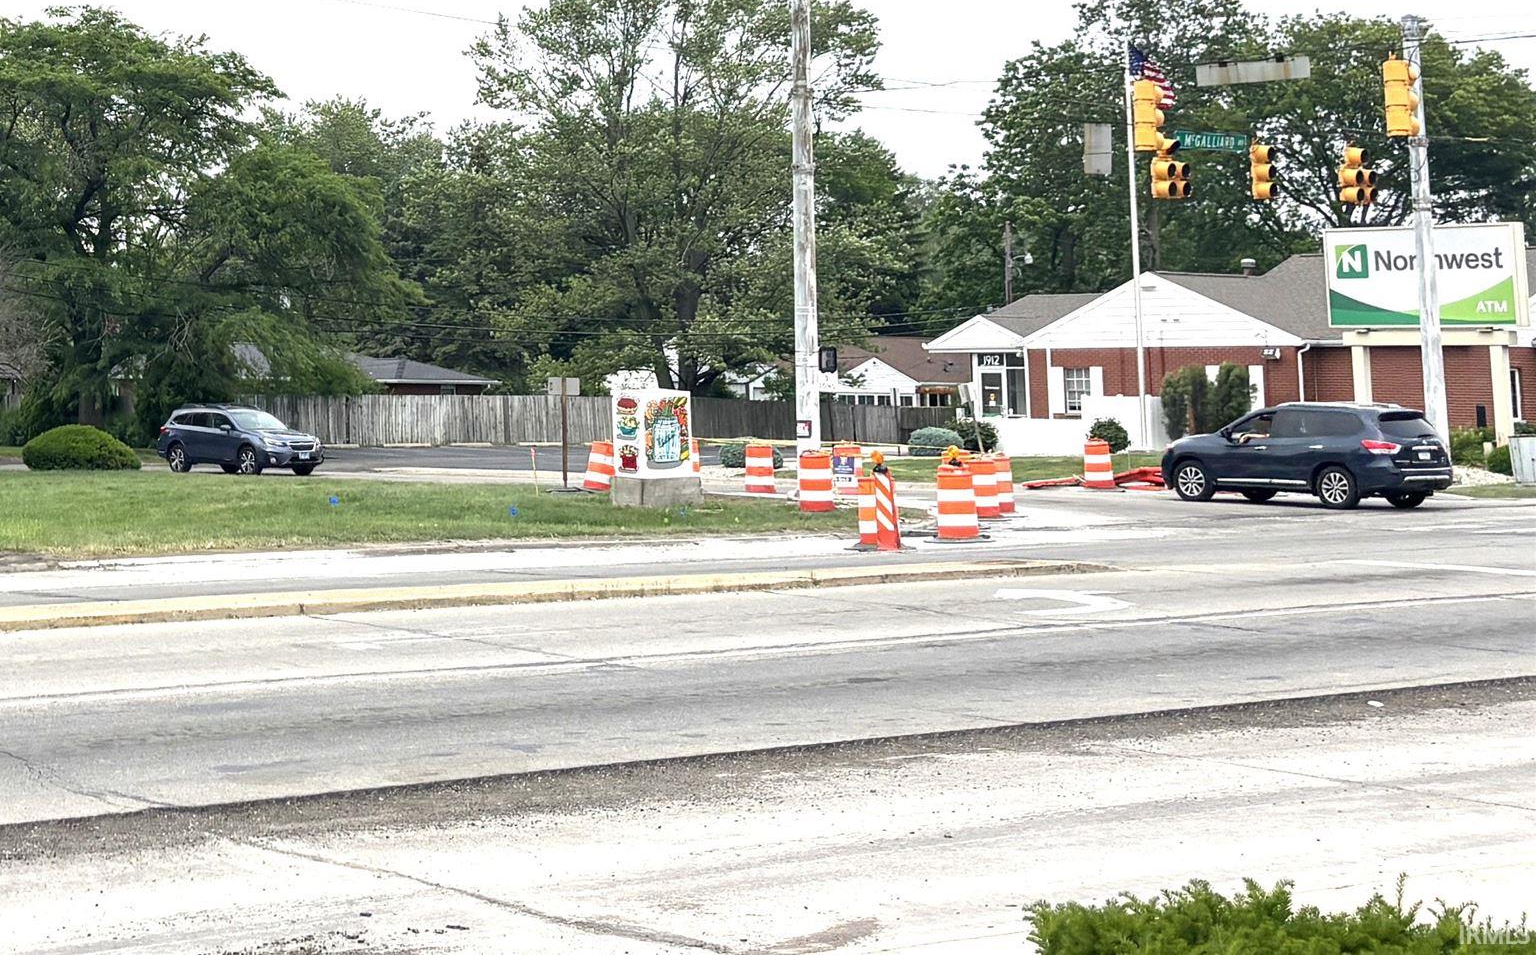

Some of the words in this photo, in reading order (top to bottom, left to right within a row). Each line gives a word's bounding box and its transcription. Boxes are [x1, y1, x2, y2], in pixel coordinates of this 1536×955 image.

[1374, 247, 1504, 271] Norwest
[1476, 300, 1508, 313] ATM
[983, 355, 1000, 366] 1912
